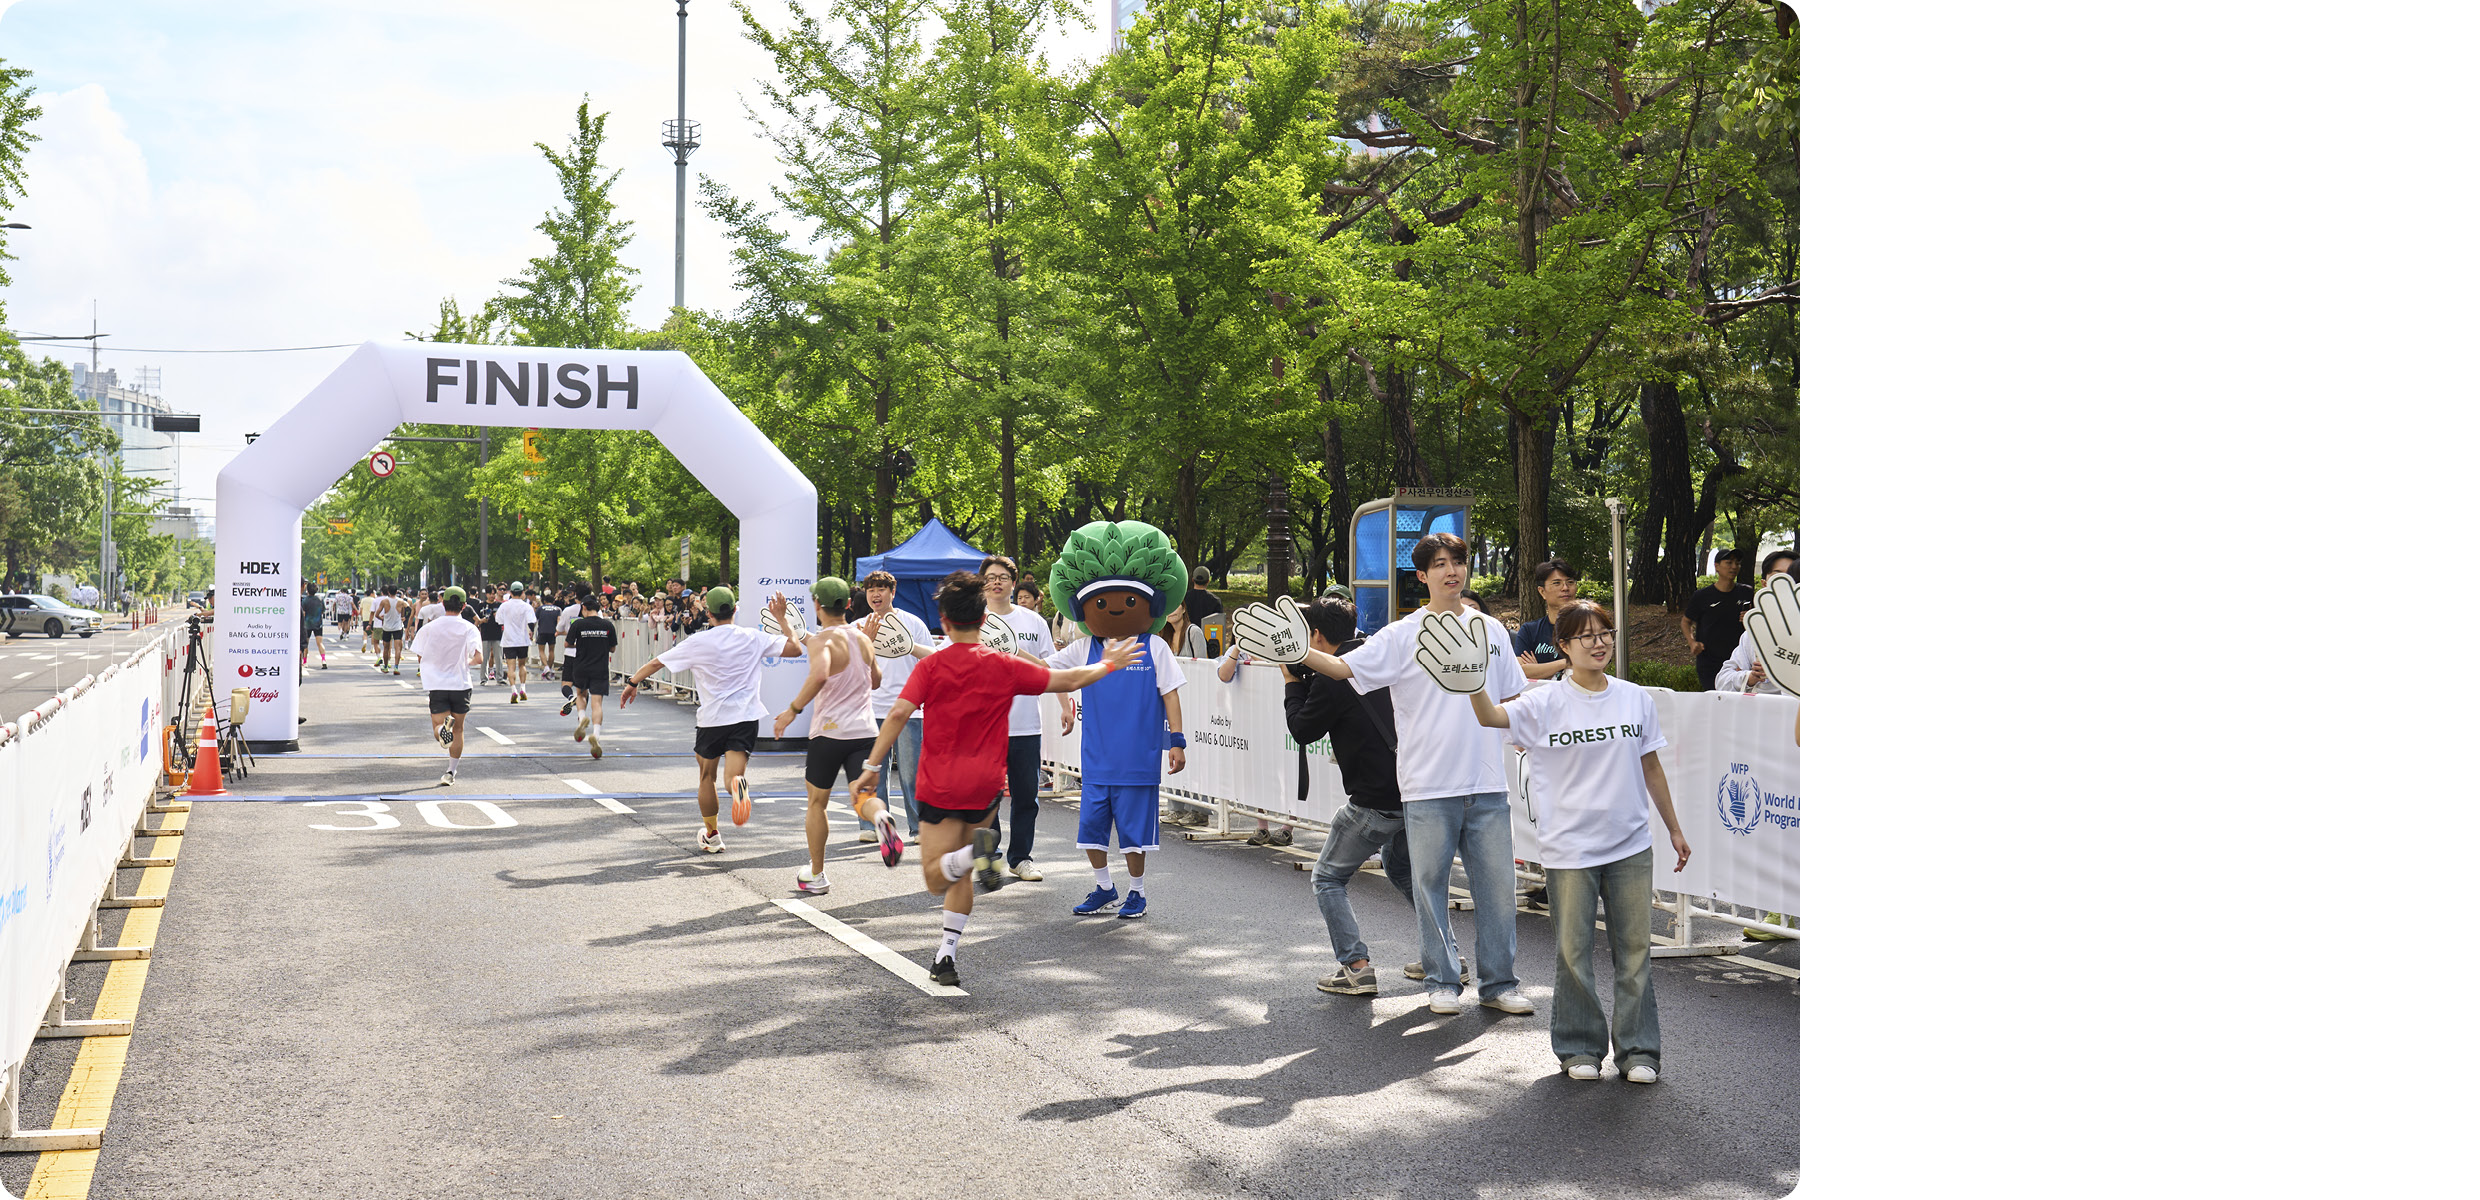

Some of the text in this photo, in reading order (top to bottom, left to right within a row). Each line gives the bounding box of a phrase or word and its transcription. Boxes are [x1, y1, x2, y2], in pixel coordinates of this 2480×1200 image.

[426, 357, 639, 409] FINISH
[240, 561, 280, 575] HDEX
[228, 631, 289, 639] BANG & OLUFSEN
[882, 633, 905, 649] 나무를
[1018, 632, 1038, 642] RUN
[1270, 627, 1293, 645] 함께
[1274, 641, 1300, 657] 달려!
[1773, 646, 1800, 666] 포레
[254, 666, 280, 677] 농심
[1210, 715, 1232, 729] Audio by
[1194, 730, 1249, 751] BANG & OLUFSEN
[1549, 724, 1643, 747] FOREST RU
[1730, 761, 1749, 775] WFP
[1764, 792, 1795, 810] World
[302, 800, 519, 831] 30
